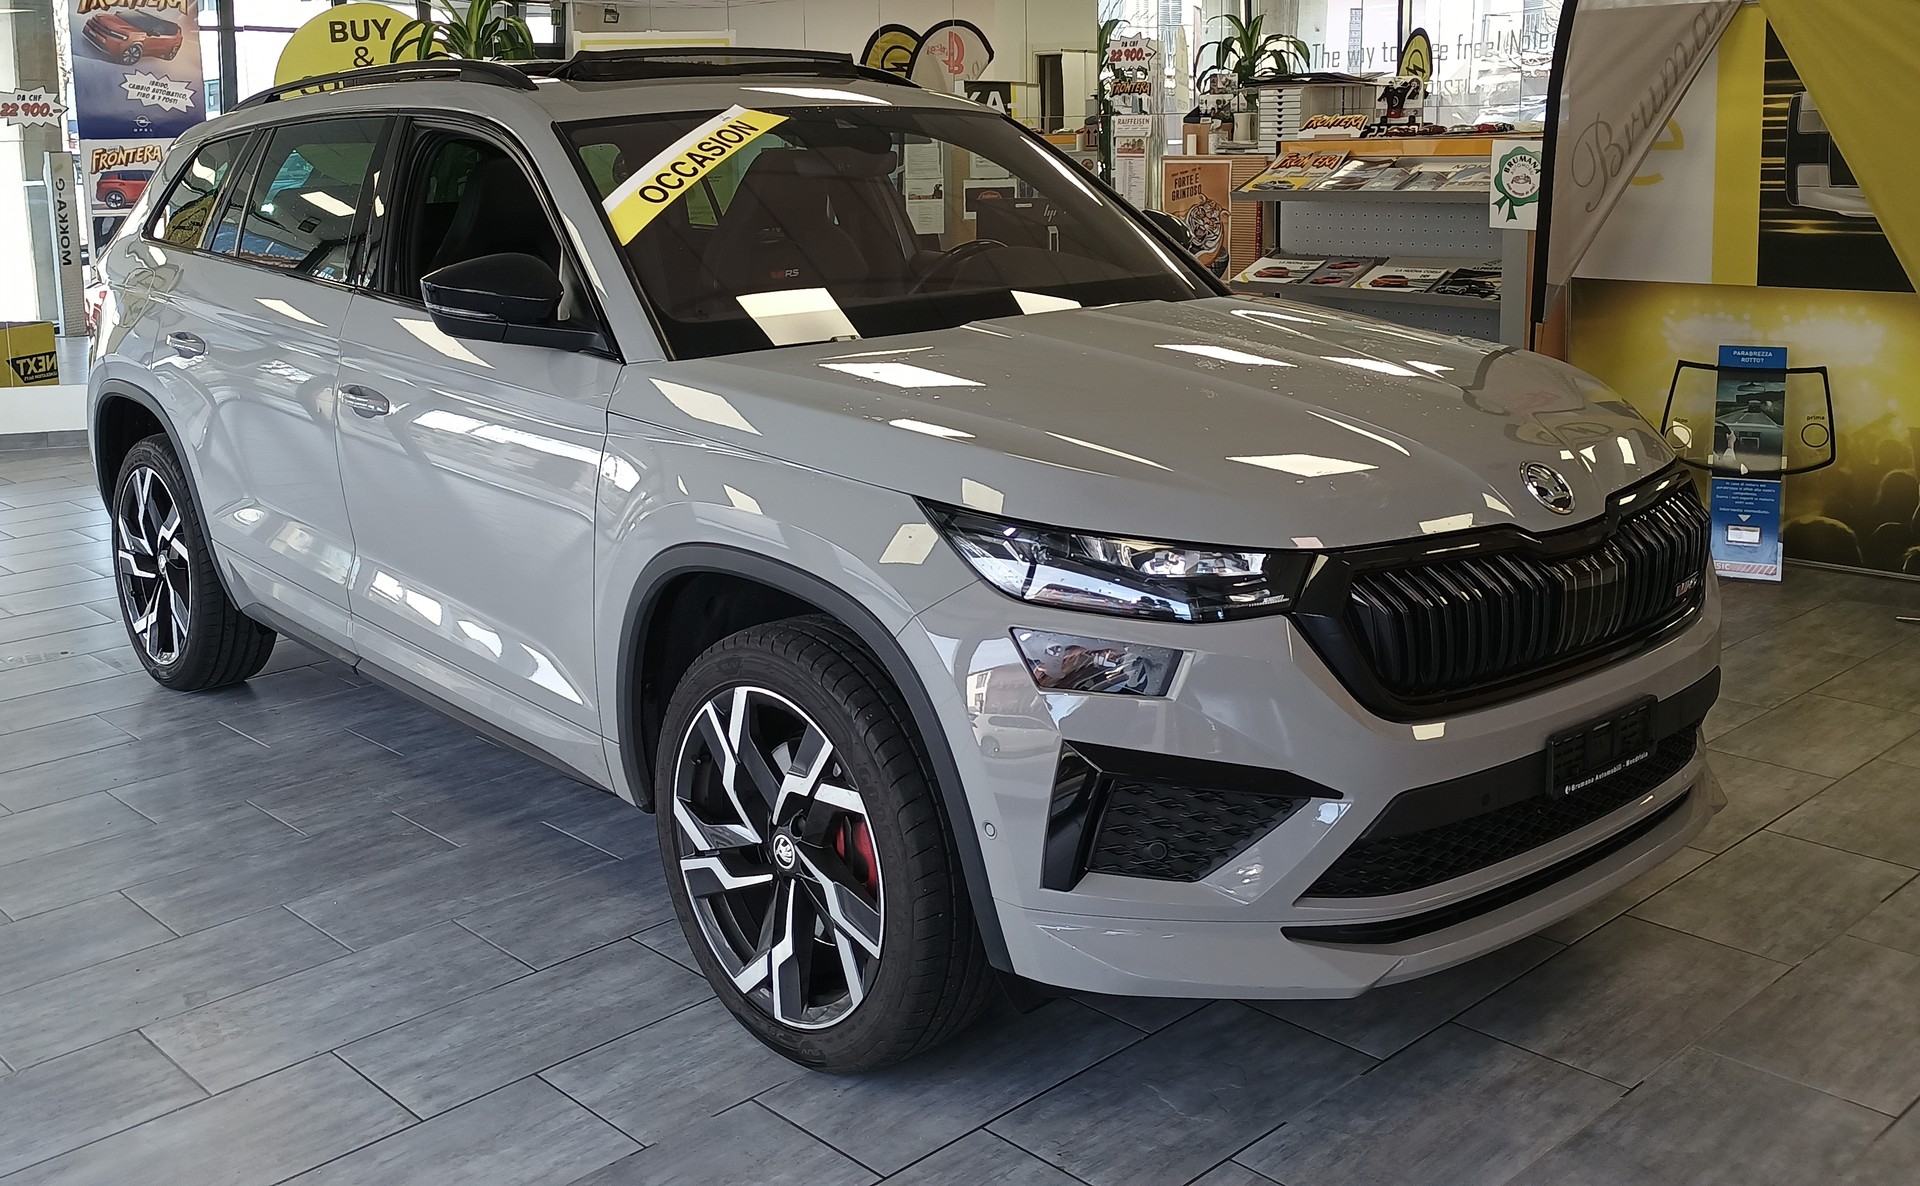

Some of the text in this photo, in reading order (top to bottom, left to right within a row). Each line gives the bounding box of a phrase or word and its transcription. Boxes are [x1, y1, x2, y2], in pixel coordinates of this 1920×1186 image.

[329, 18, 391, 42] BUY
[353, 46, 374, 67] &
[1110, 49, 1123, 62] 22
[1312, 43, 1340, 69] The
[0, 102, 19, 117] 22
[91, 145, 163, 174] FRONTERA
[639, 120, 759, 203] OCCASION
[1504, 155, 1541, 174] BRUMANA
[1174, 174, 1194, 189] FORTE
[1195, 172, 1200, 184] E
[1171, 184, 1202, 201] GRINTOSO
